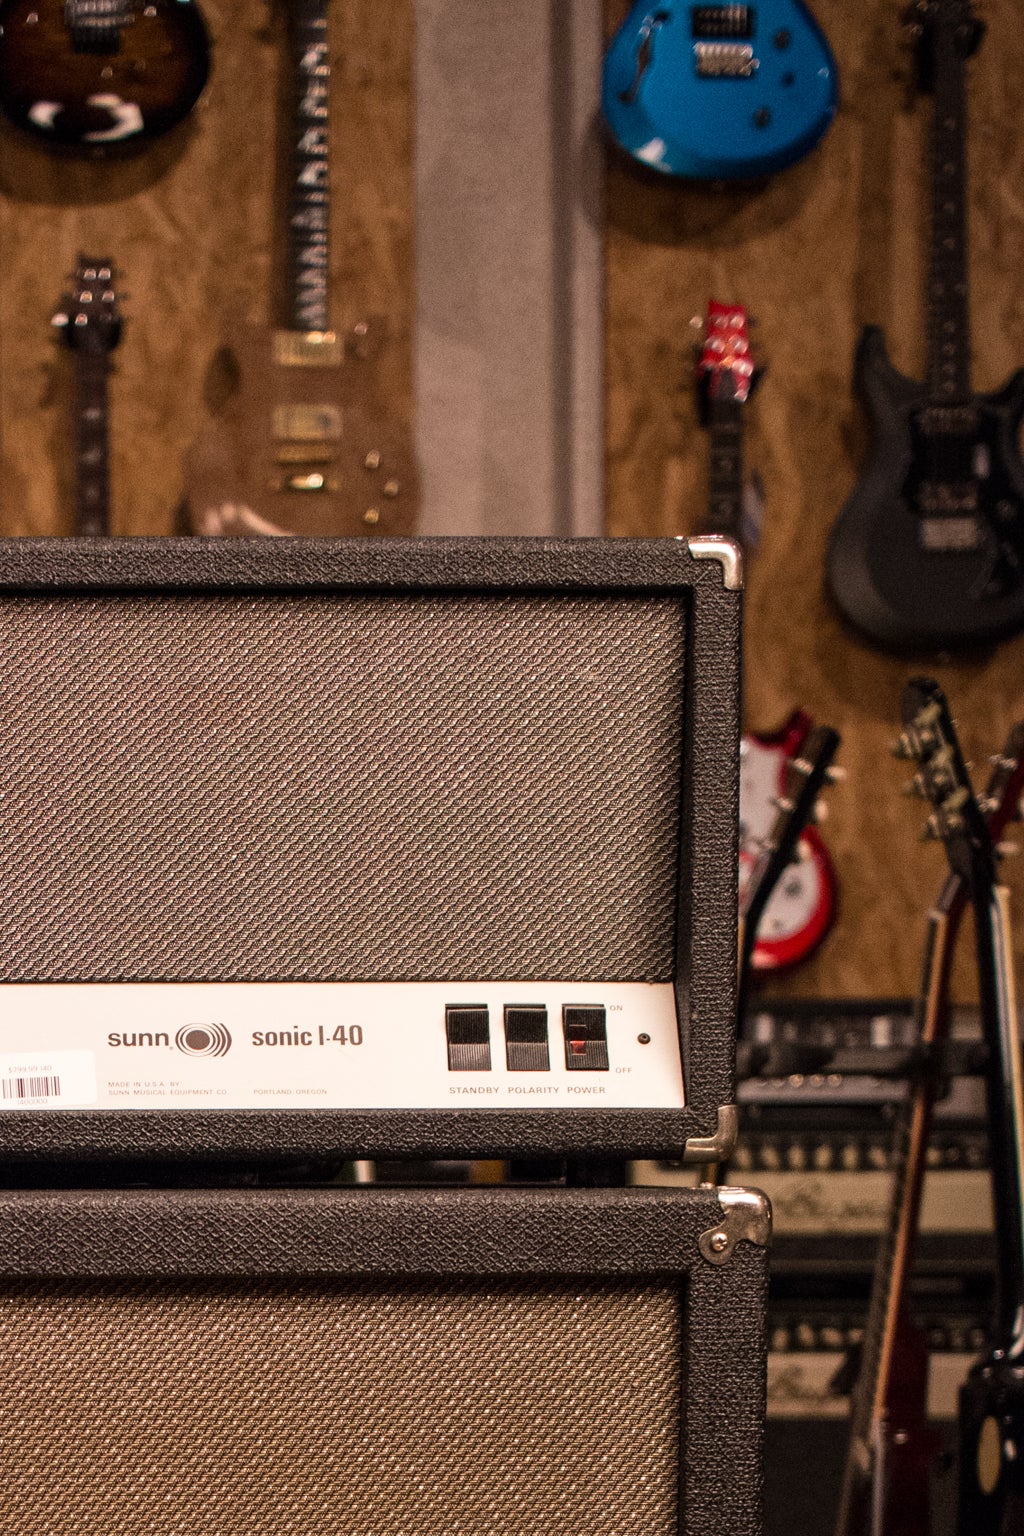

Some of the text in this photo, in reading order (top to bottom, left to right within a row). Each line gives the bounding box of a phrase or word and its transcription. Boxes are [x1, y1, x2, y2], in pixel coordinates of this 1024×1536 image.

[609, 1004, 623, 1012] ON
[251, 1025, 313, 1046] sonic
[449, 1086, 500, 1094] STANDBY
[507, 1086, 560, 1094] POLARITY
[567, 1086, 606, 1094] POWER
